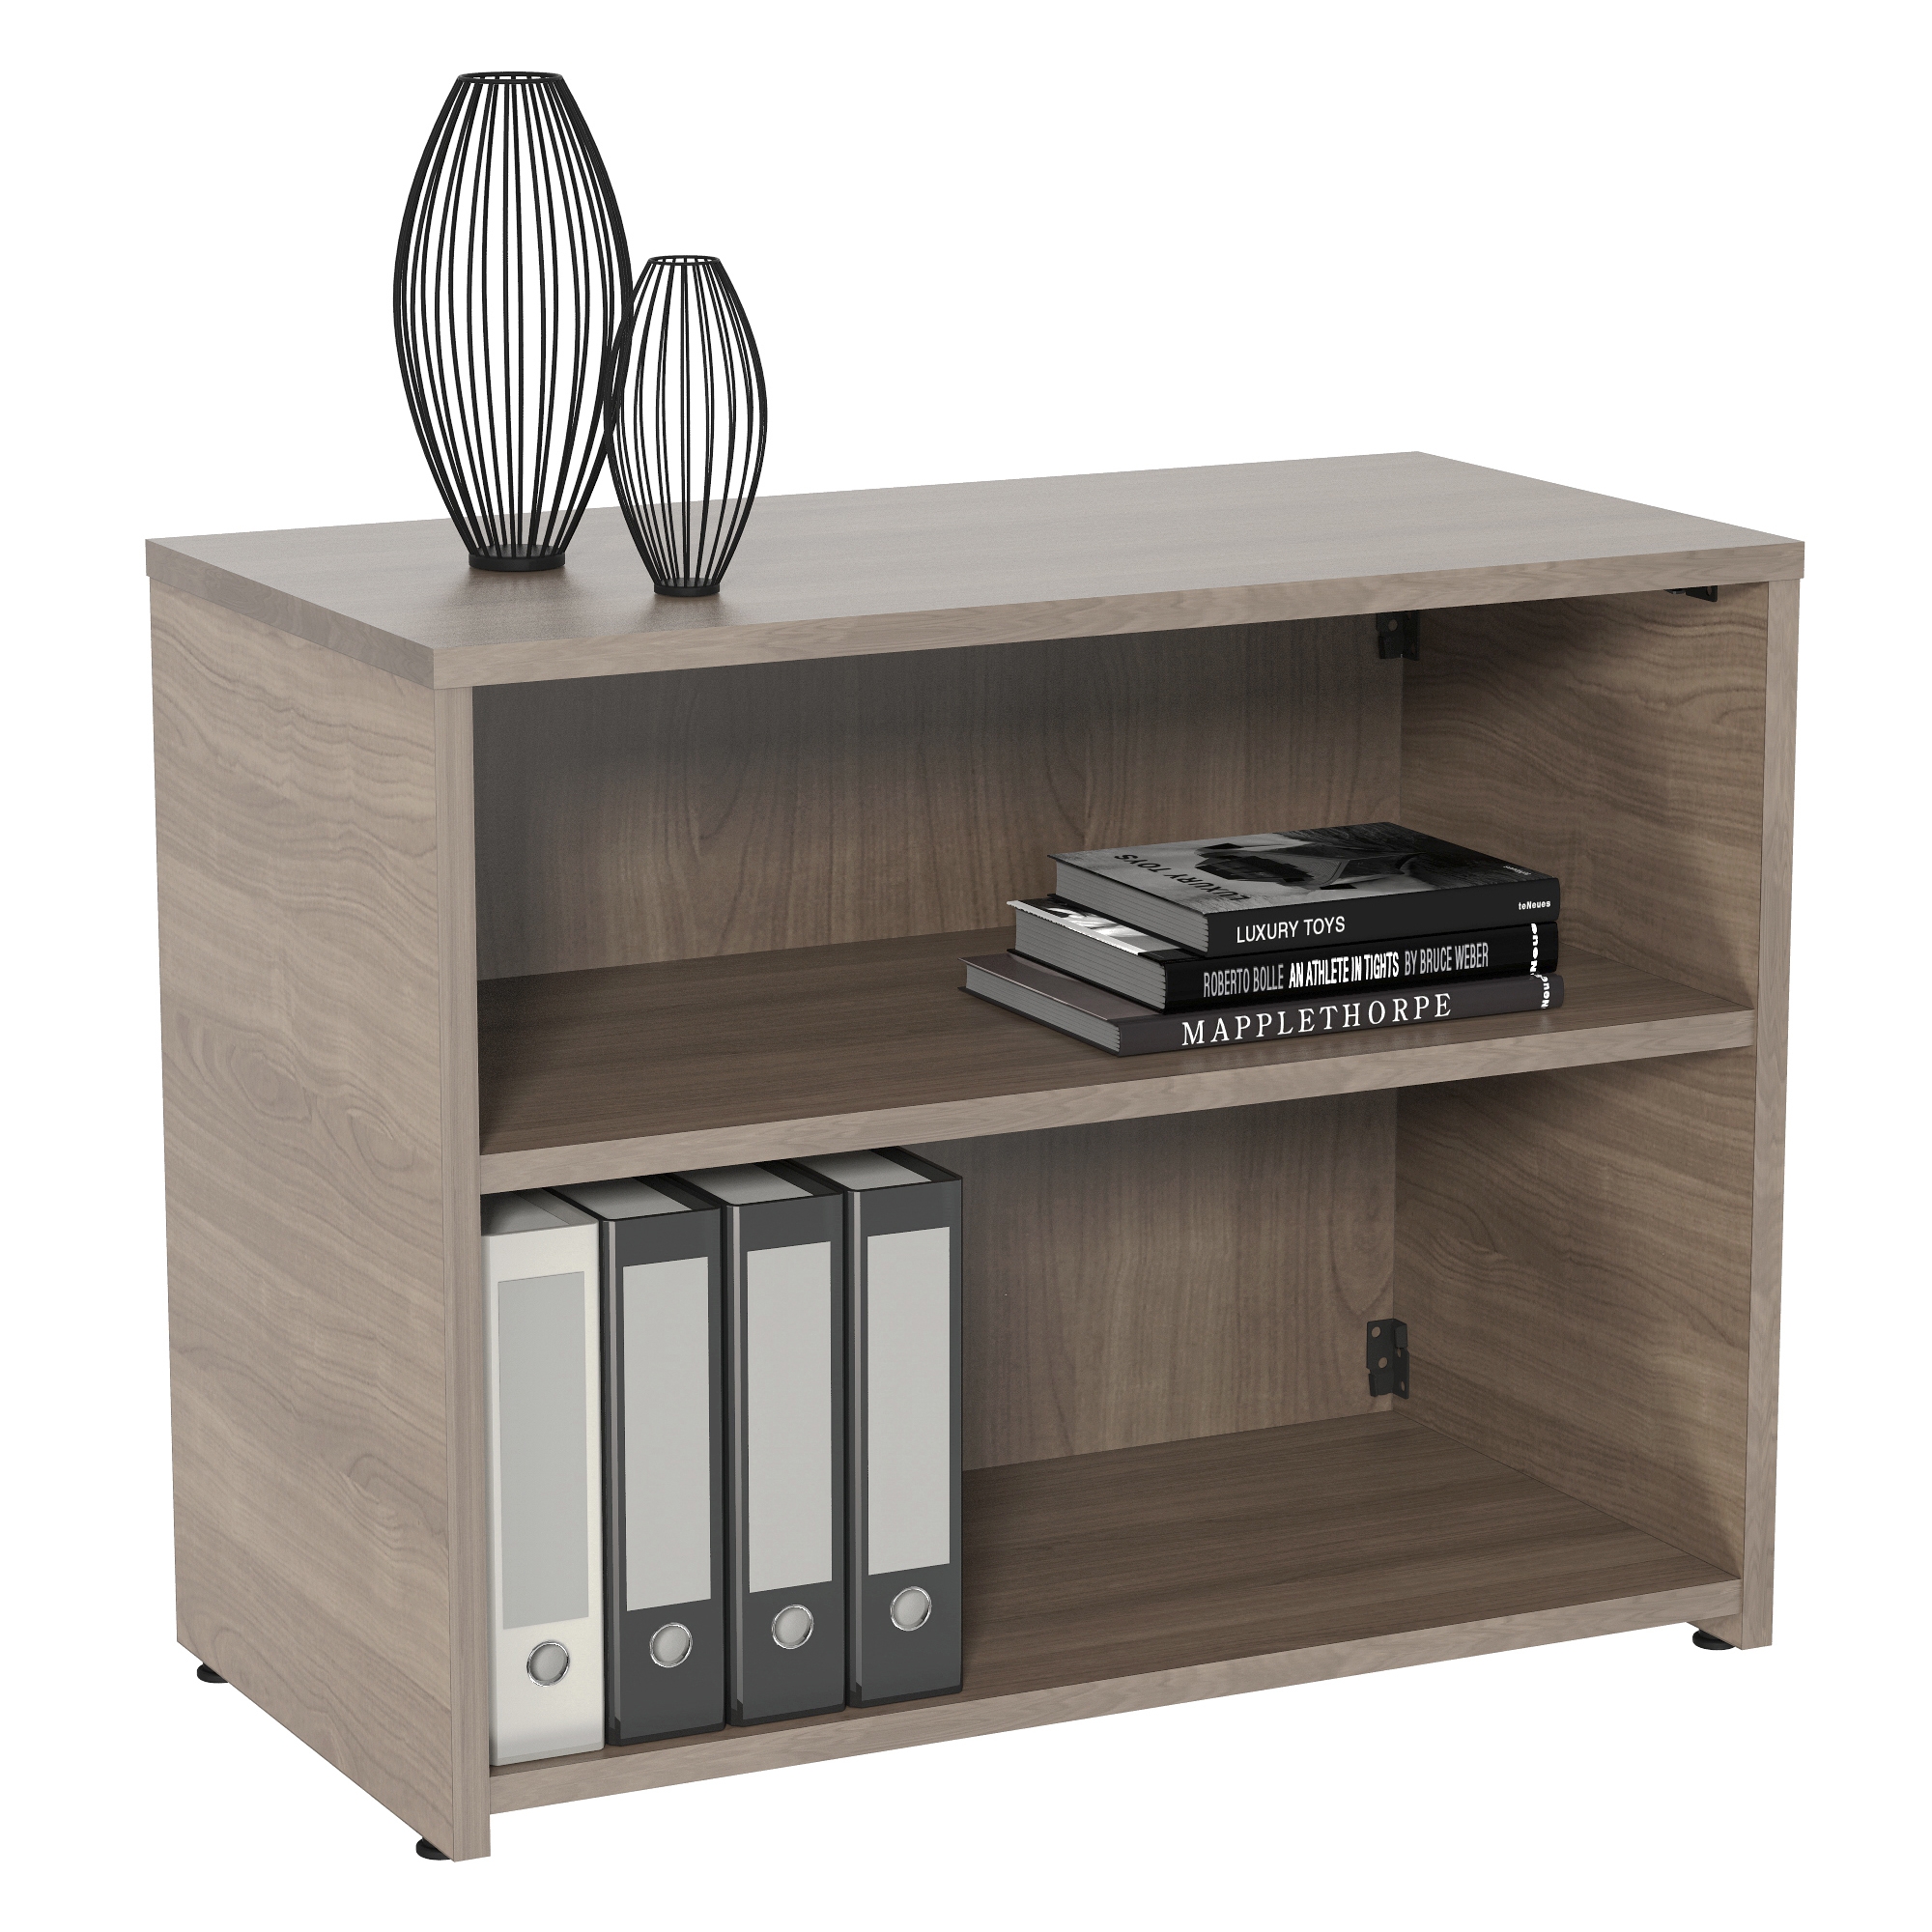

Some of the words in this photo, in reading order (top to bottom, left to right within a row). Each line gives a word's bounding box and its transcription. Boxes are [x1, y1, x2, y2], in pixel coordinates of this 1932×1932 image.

[1114, 854, 1171, 873] TOYS
[1163, 873, 1251, 901] LUXURY
[1518, 900, 1551, 911] teNeues
[1236, 920, 1299, 943] LUXURY
[1303, 916, 1346, 936] TOYS
[1203, 968, 1250, 998] ROBERTO
[1253, 963, 1284, 993] BOLLE
[1289, 961, 1304, 988] AN
[1305, 956, 1350, 986] ATHLETE
[1350, 955, 1362, 982] IN
[1363, 951, 1400, 980] TIGHTS
[1404, 949, 1418, 976] BY
[1419, 945, 1453, 975] BRUCE
[1454, 941, 1489, 971] WEBER
[1181, 993, 1451, 1046] MAPPLETHORPE
